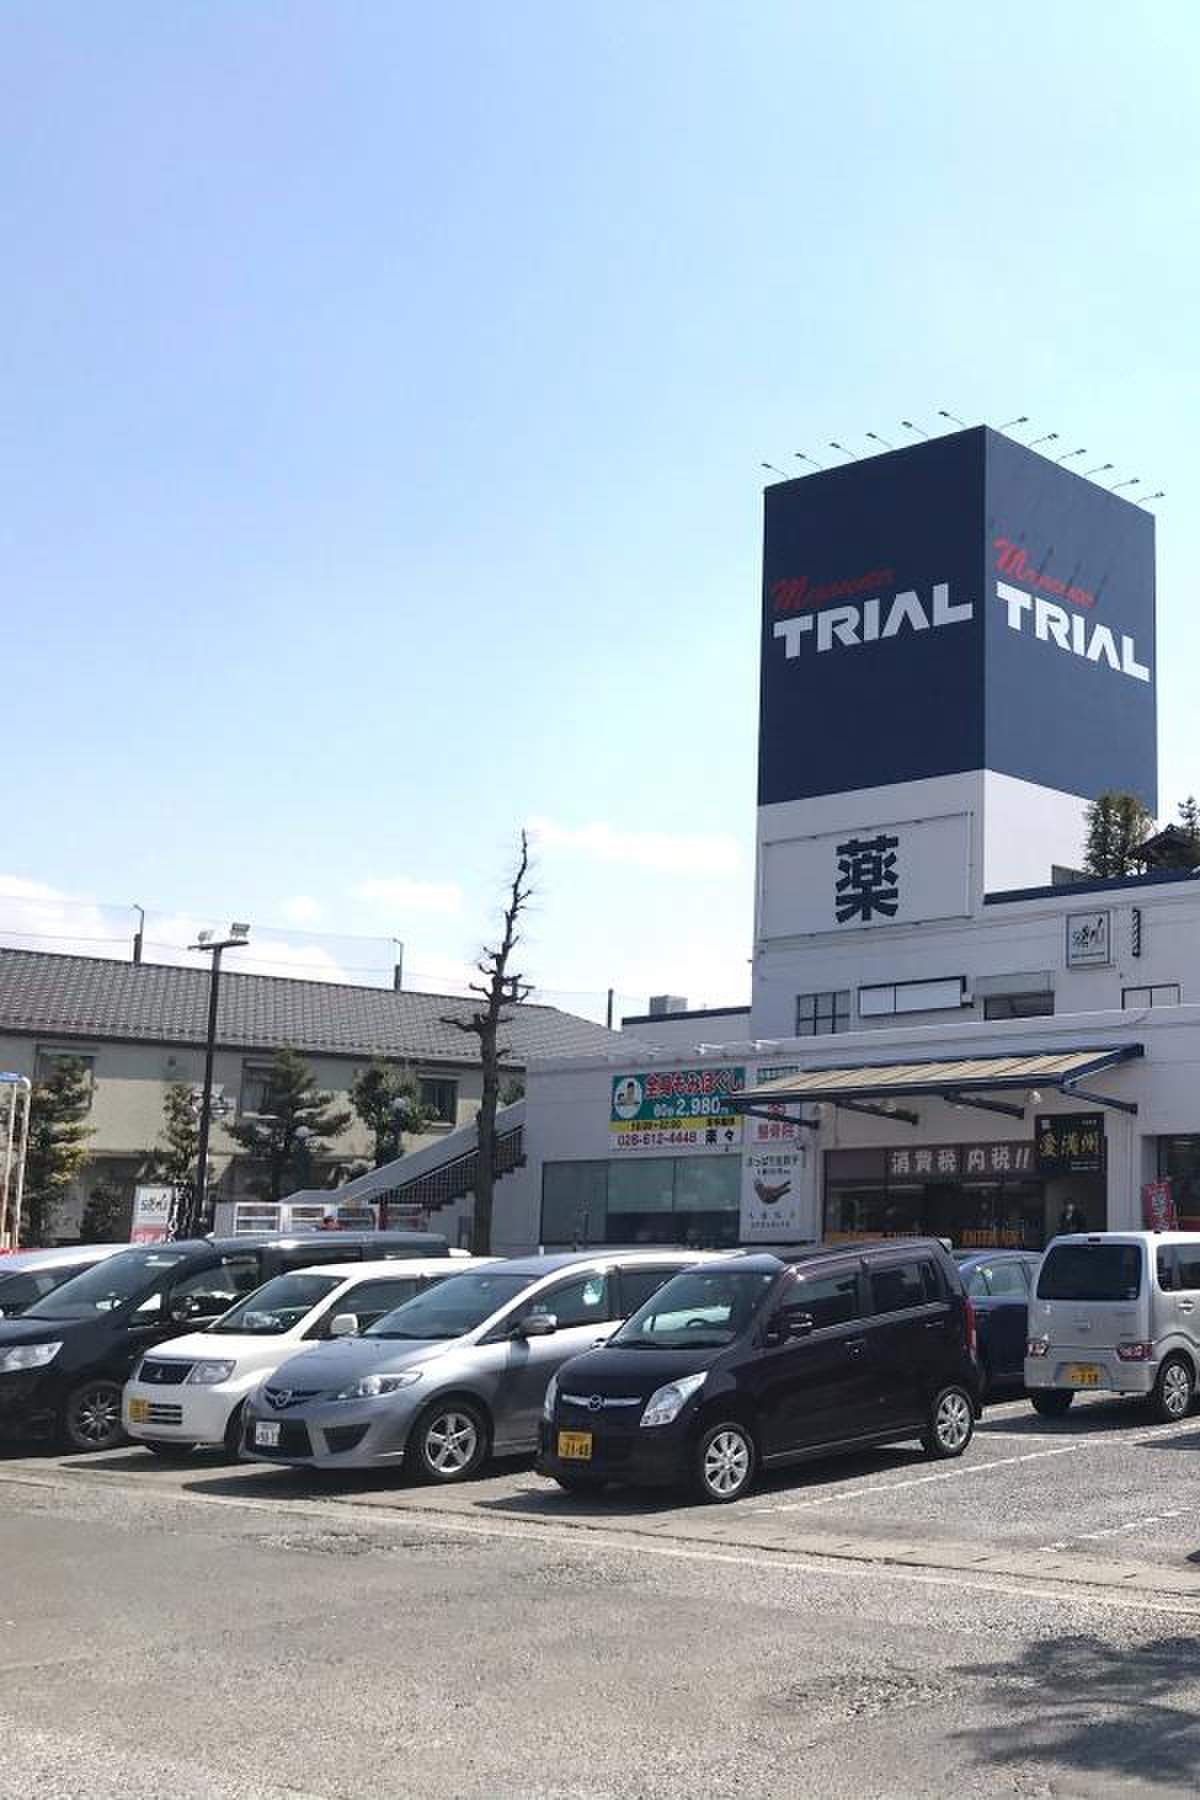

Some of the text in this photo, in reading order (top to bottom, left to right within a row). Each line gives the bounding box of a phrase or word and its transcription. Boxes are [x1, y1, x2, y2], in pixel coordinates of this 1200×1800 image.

[773, 582, 974, 659] TRIAL
[996, 581, 1151, 683] TRIAL
[835, 834, 899, 923] 薬
